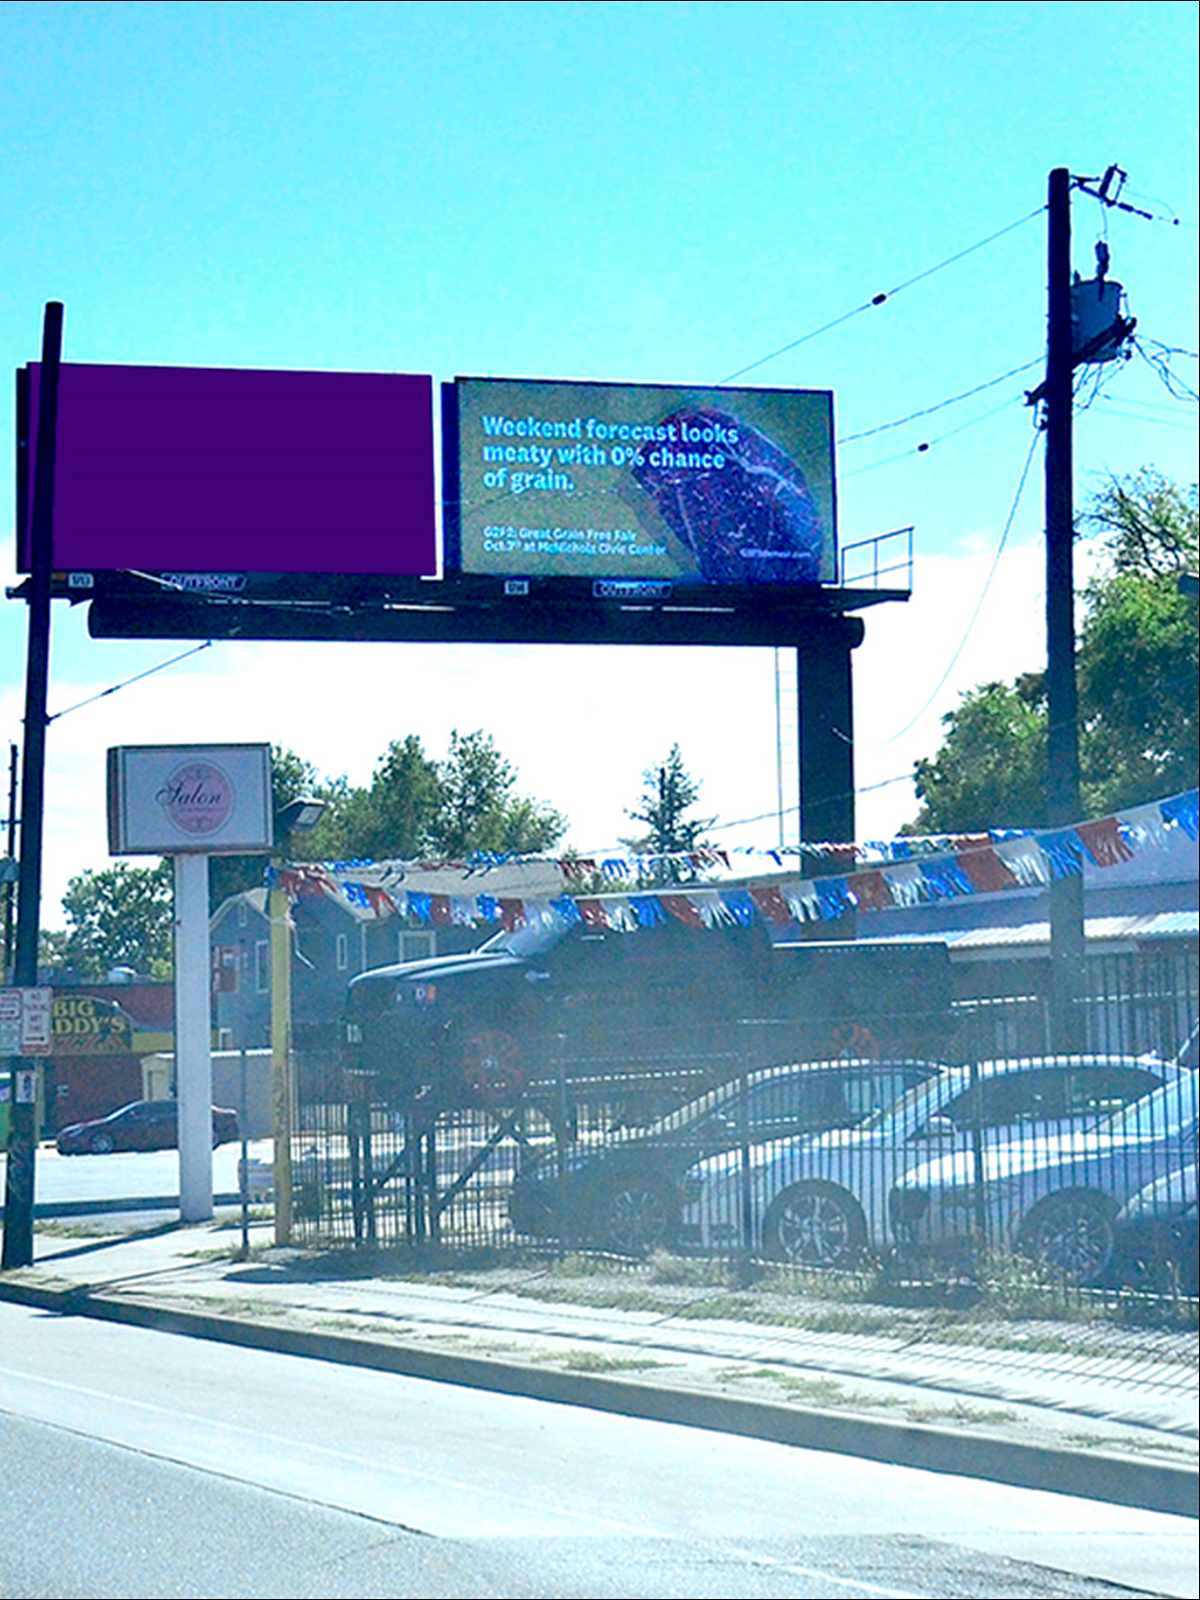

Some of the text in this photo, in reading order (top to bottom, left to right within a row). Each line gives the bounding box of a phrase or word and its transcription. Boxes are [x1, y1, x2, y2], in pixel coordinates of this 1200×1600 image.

[482, 416, 739, 443] Weekend forecast looks
[483, 443, 727, 469] meaty with 0% chance
[483, 467, 576, 494] of grain.
[519, 527, 551, 540] Great
[553, 528, 584, 540] Grain
[587, 529, 612, 541] Free
[614, 530, 636, 541] Fair
[155, 782, 221, 806] Salon
[53, 1000, 94, 1016] BIG
[51, 1016, 126, 1034] DDY'S
